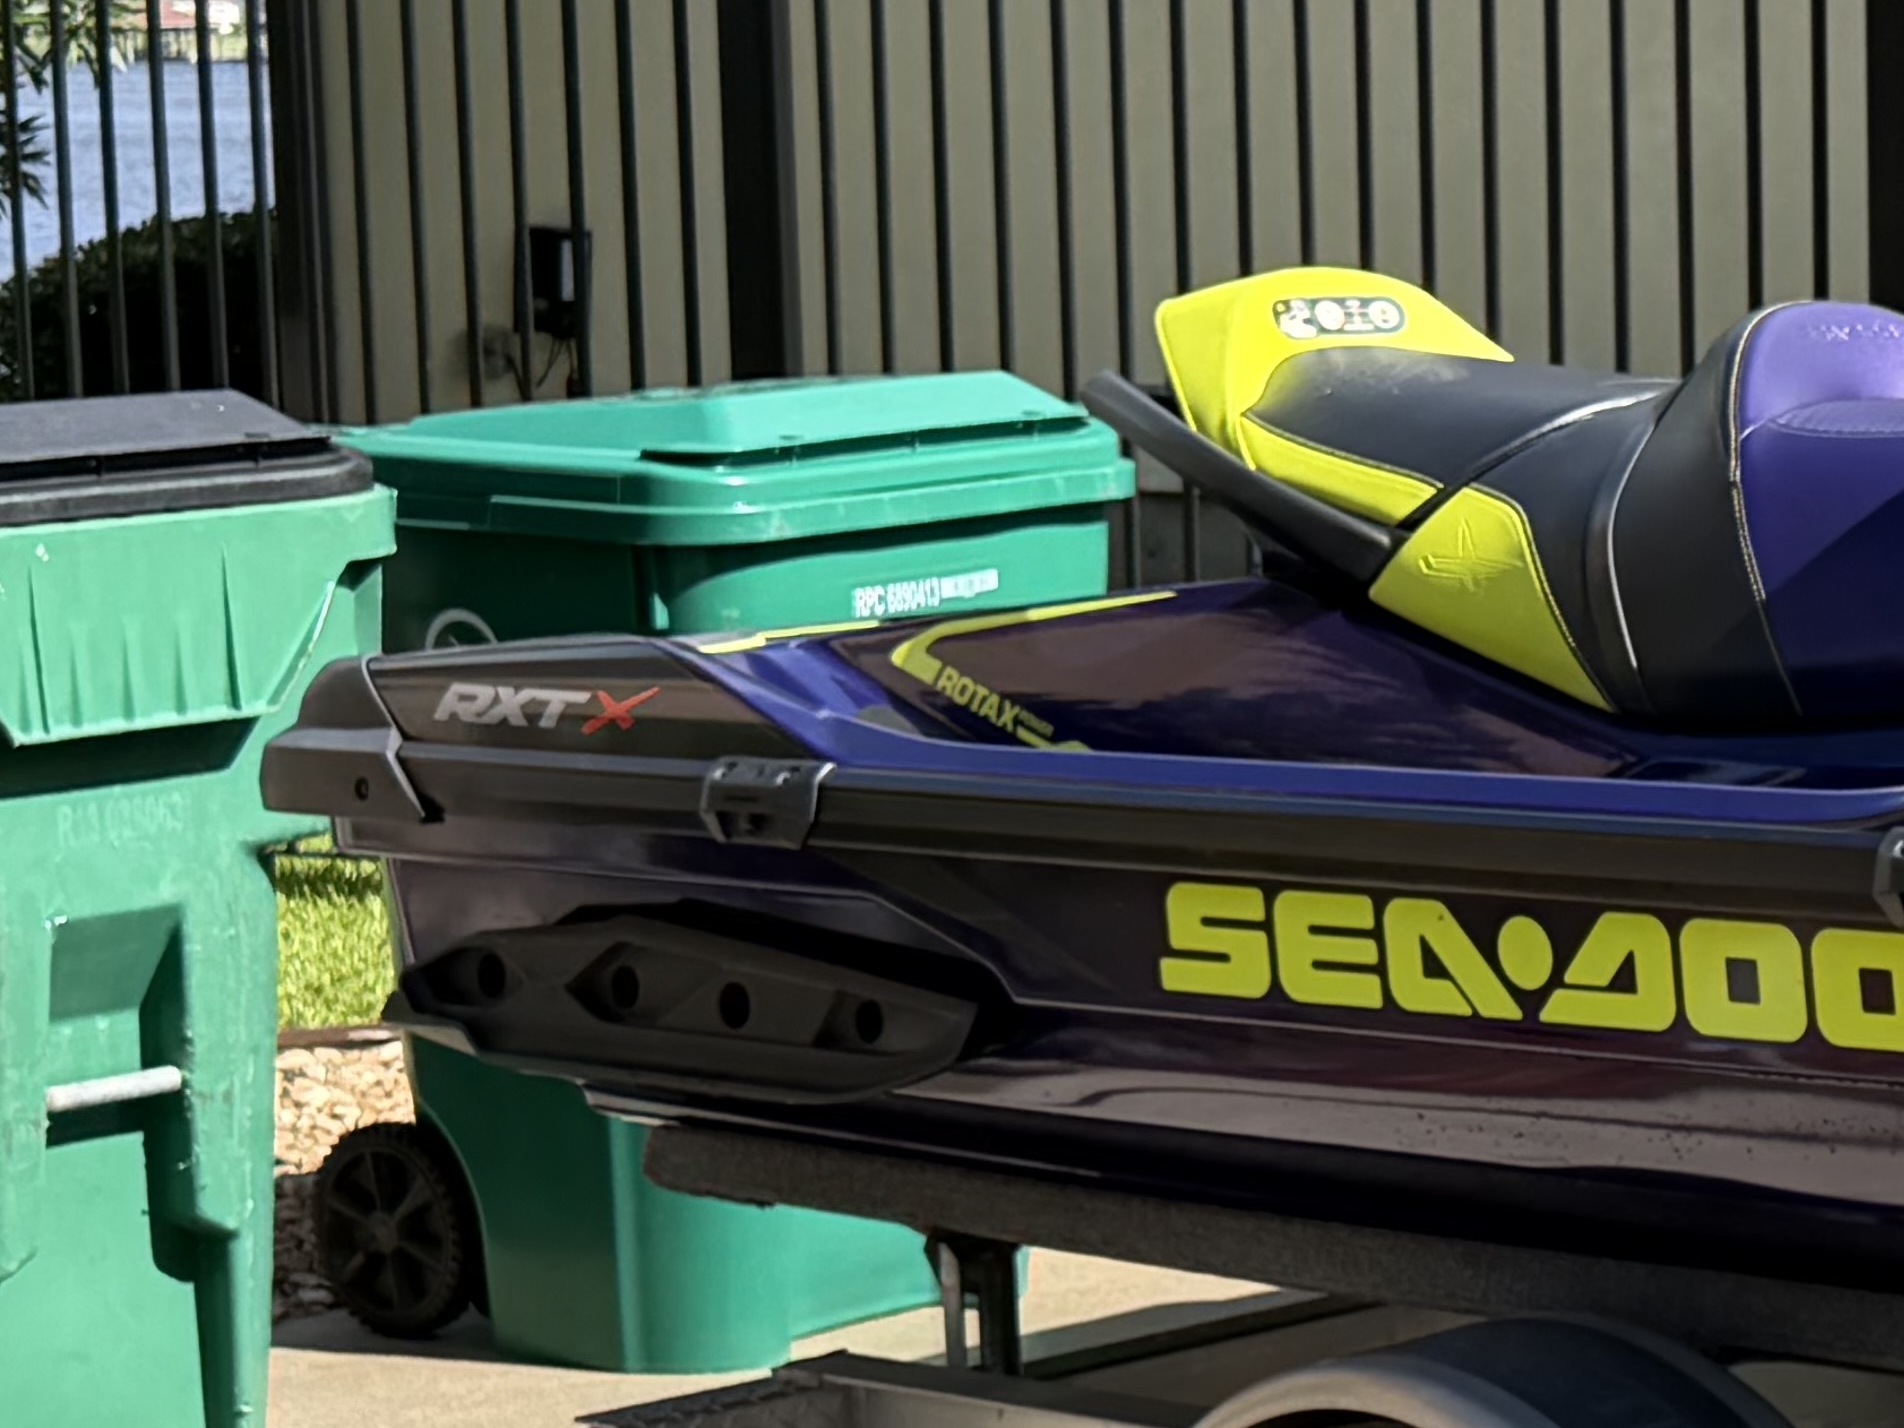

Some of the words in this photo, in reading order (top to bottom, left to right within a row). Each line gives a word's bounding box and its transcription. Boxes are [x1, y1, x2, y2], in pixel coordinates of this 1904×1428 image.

[854, 584, 886, 618] RPC
[434, 682, 592, 729] RXT
[936, 665, 1020, 732] ROTAX
